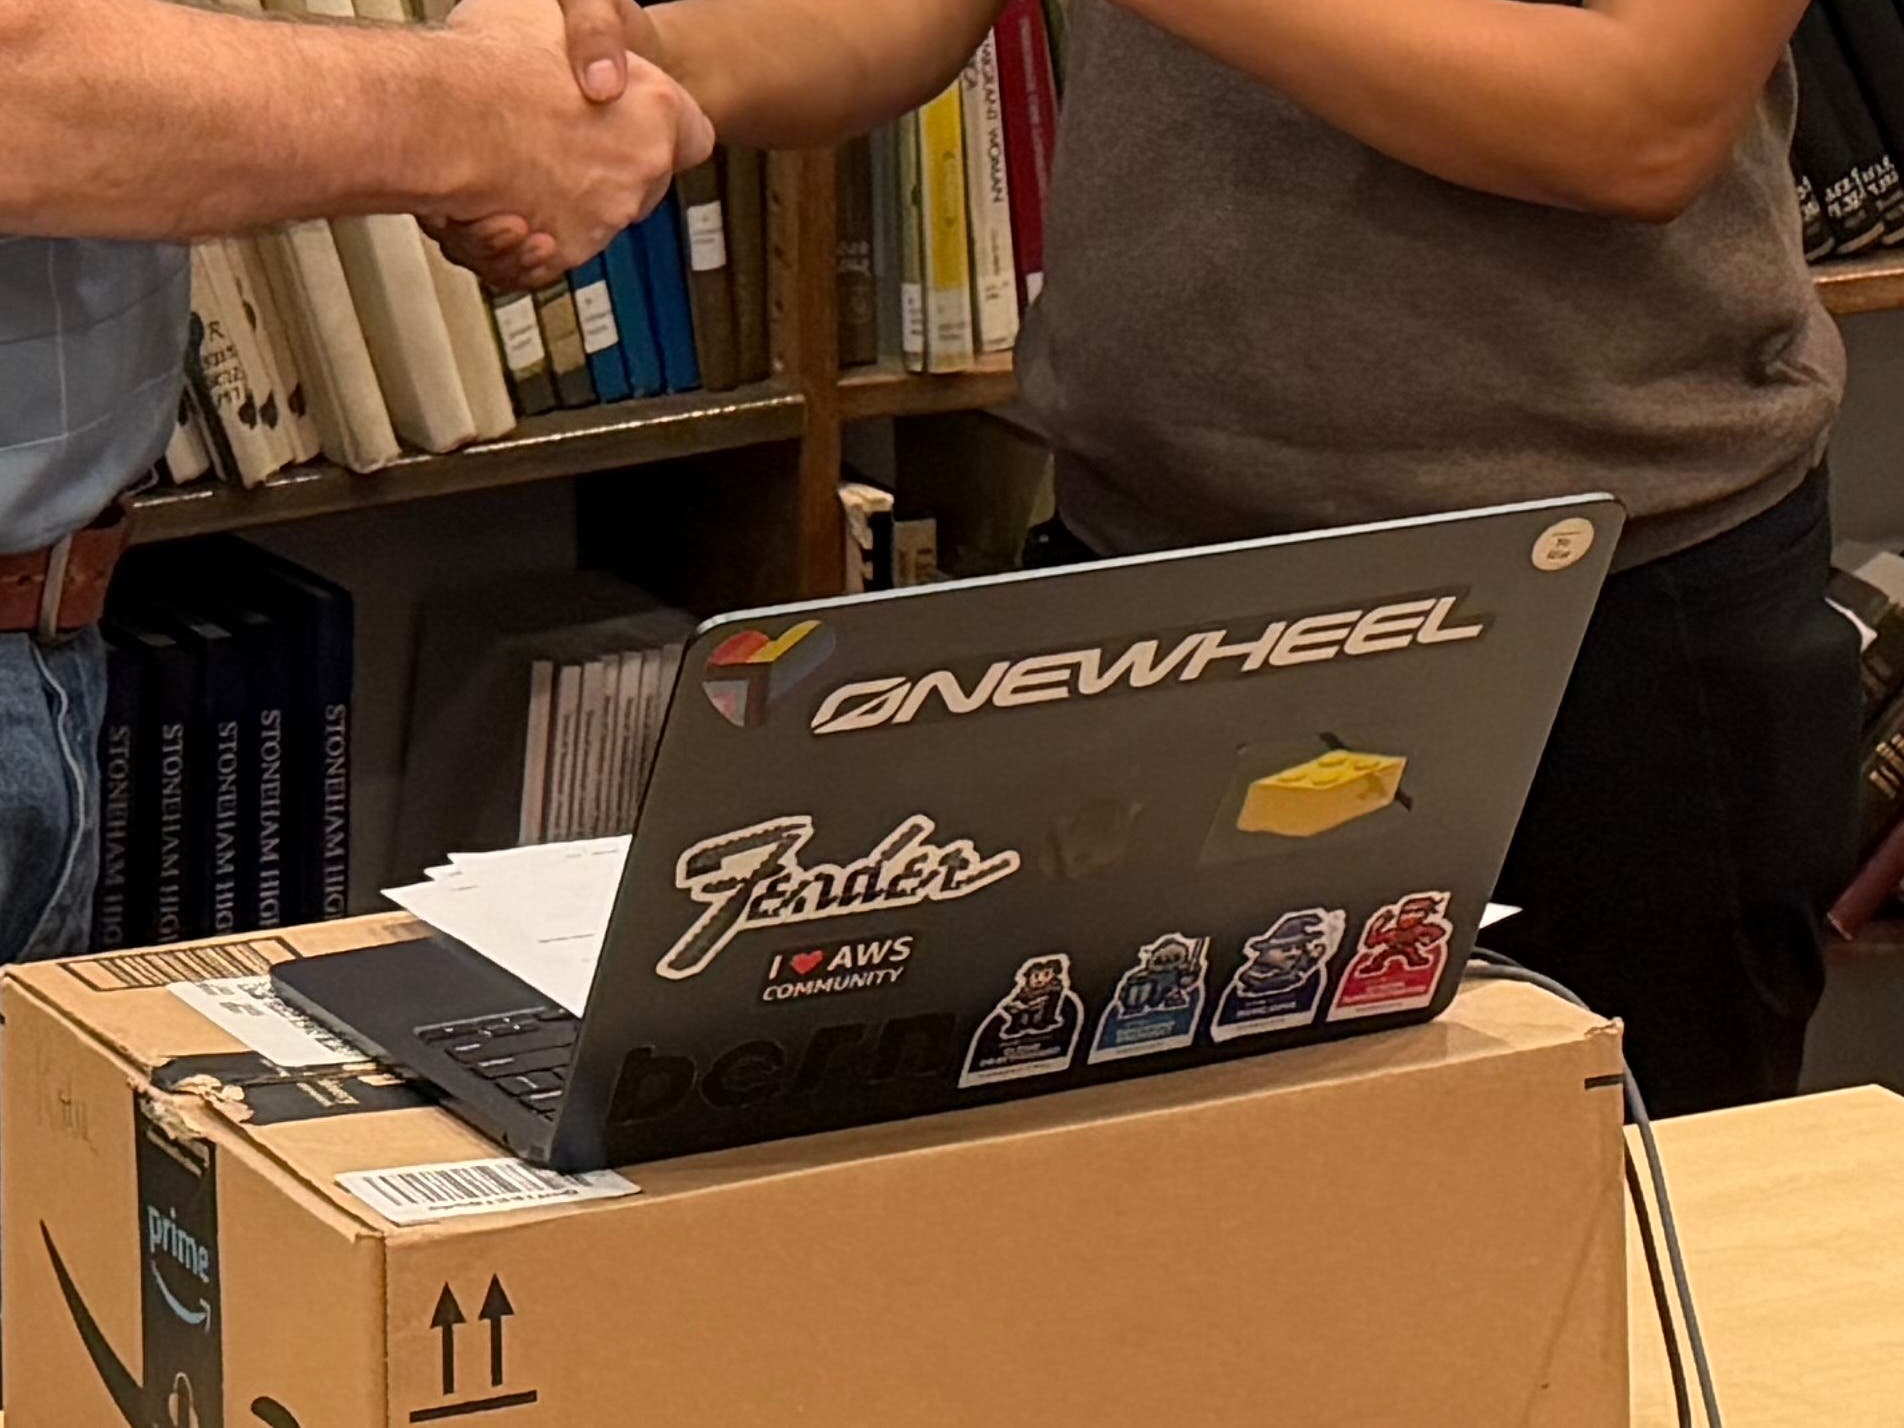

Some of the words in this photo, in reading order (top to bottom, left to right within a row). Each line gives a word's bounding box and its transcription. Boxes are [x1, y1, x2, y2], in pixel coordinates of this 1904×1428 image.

[809, 594, 1484, 736] ONEWHEEL
[103, 725, 130, 887] STONEHAM
[159, 723, 184, 878] STONEHAM
[215, 721, 238, 875] STONEHAM
[259, 709, 282, 863] STONEHAM
[323, 703, 346, 859] STONEHAM
[102, 894, 124, 944] HIG
[215, 881, 236, 935] HIG
[322, 864, 345, 920] HIG
[659, 817, 1017, 977] Fender
[768, 954, 781, 980] I
[827, 936, 914, 972] AWS
[762, 965, 905, 1002] COMMUNITY
[148, 1205, 211, 1284] prime
